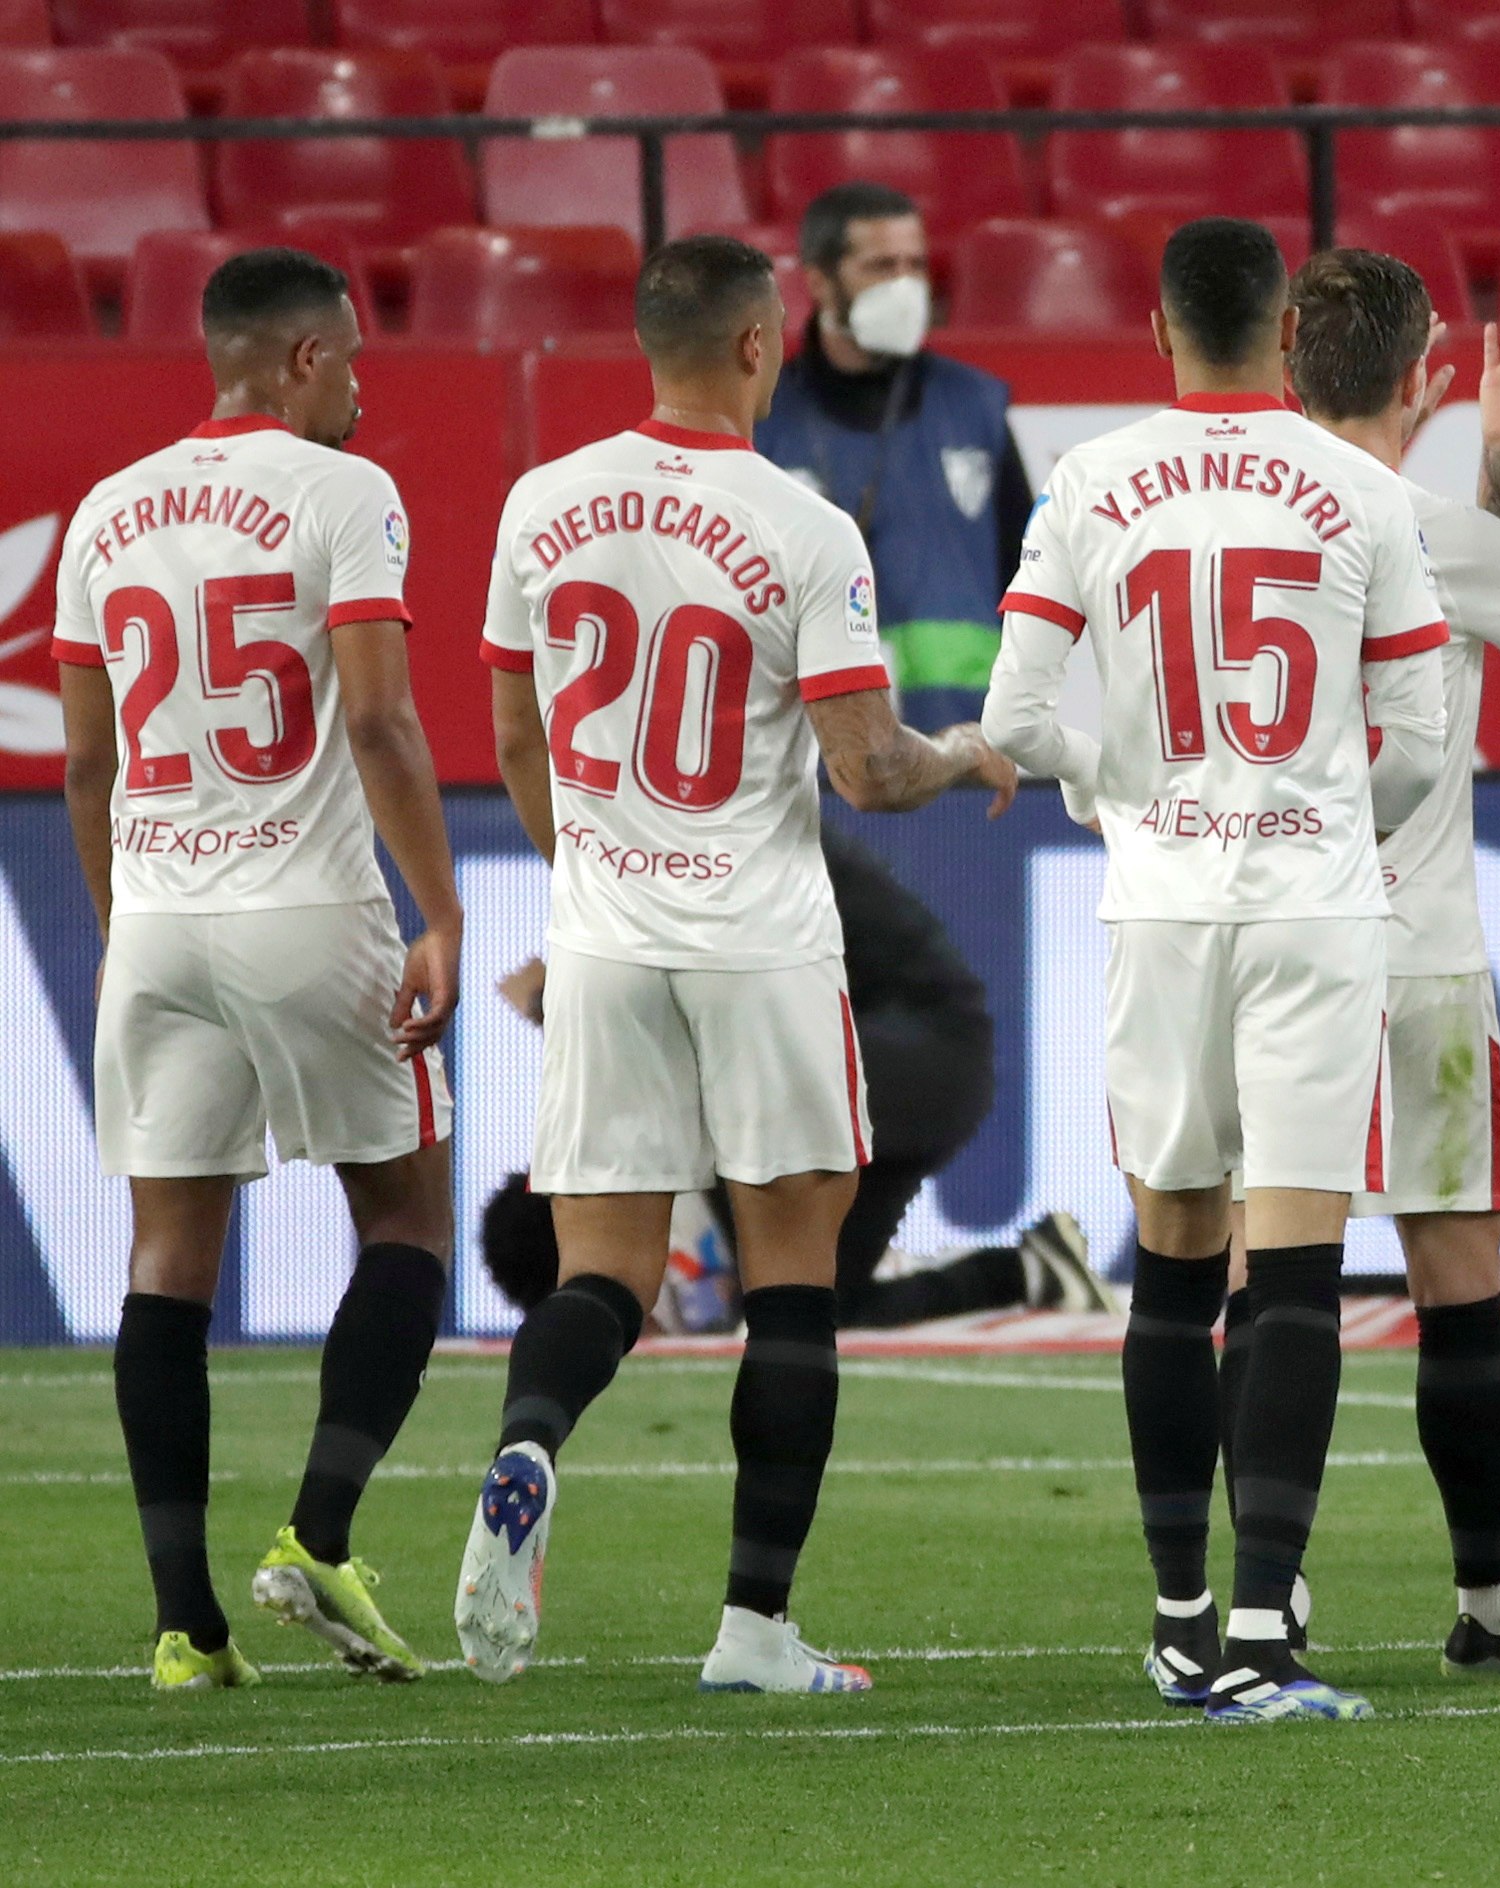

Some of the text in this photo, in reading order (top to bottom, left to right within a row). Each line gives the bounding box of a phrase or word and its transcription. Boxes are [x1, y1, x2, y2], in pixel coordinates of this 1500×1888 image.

[94, 484, 292, 566] FERNANDO
[1090, 452, 1353, 544] Y.EN NESYRI
[529, 490, 786, 616] DIEGO CARLOS
[103, 571, 318, 798] 25
[543, 579, 754, 815] 20
[1116, 547, 1323, 765] 15
[111, 816, 300, 866] AliExpress
[1134, 798, 1324, 852] AliExpress
